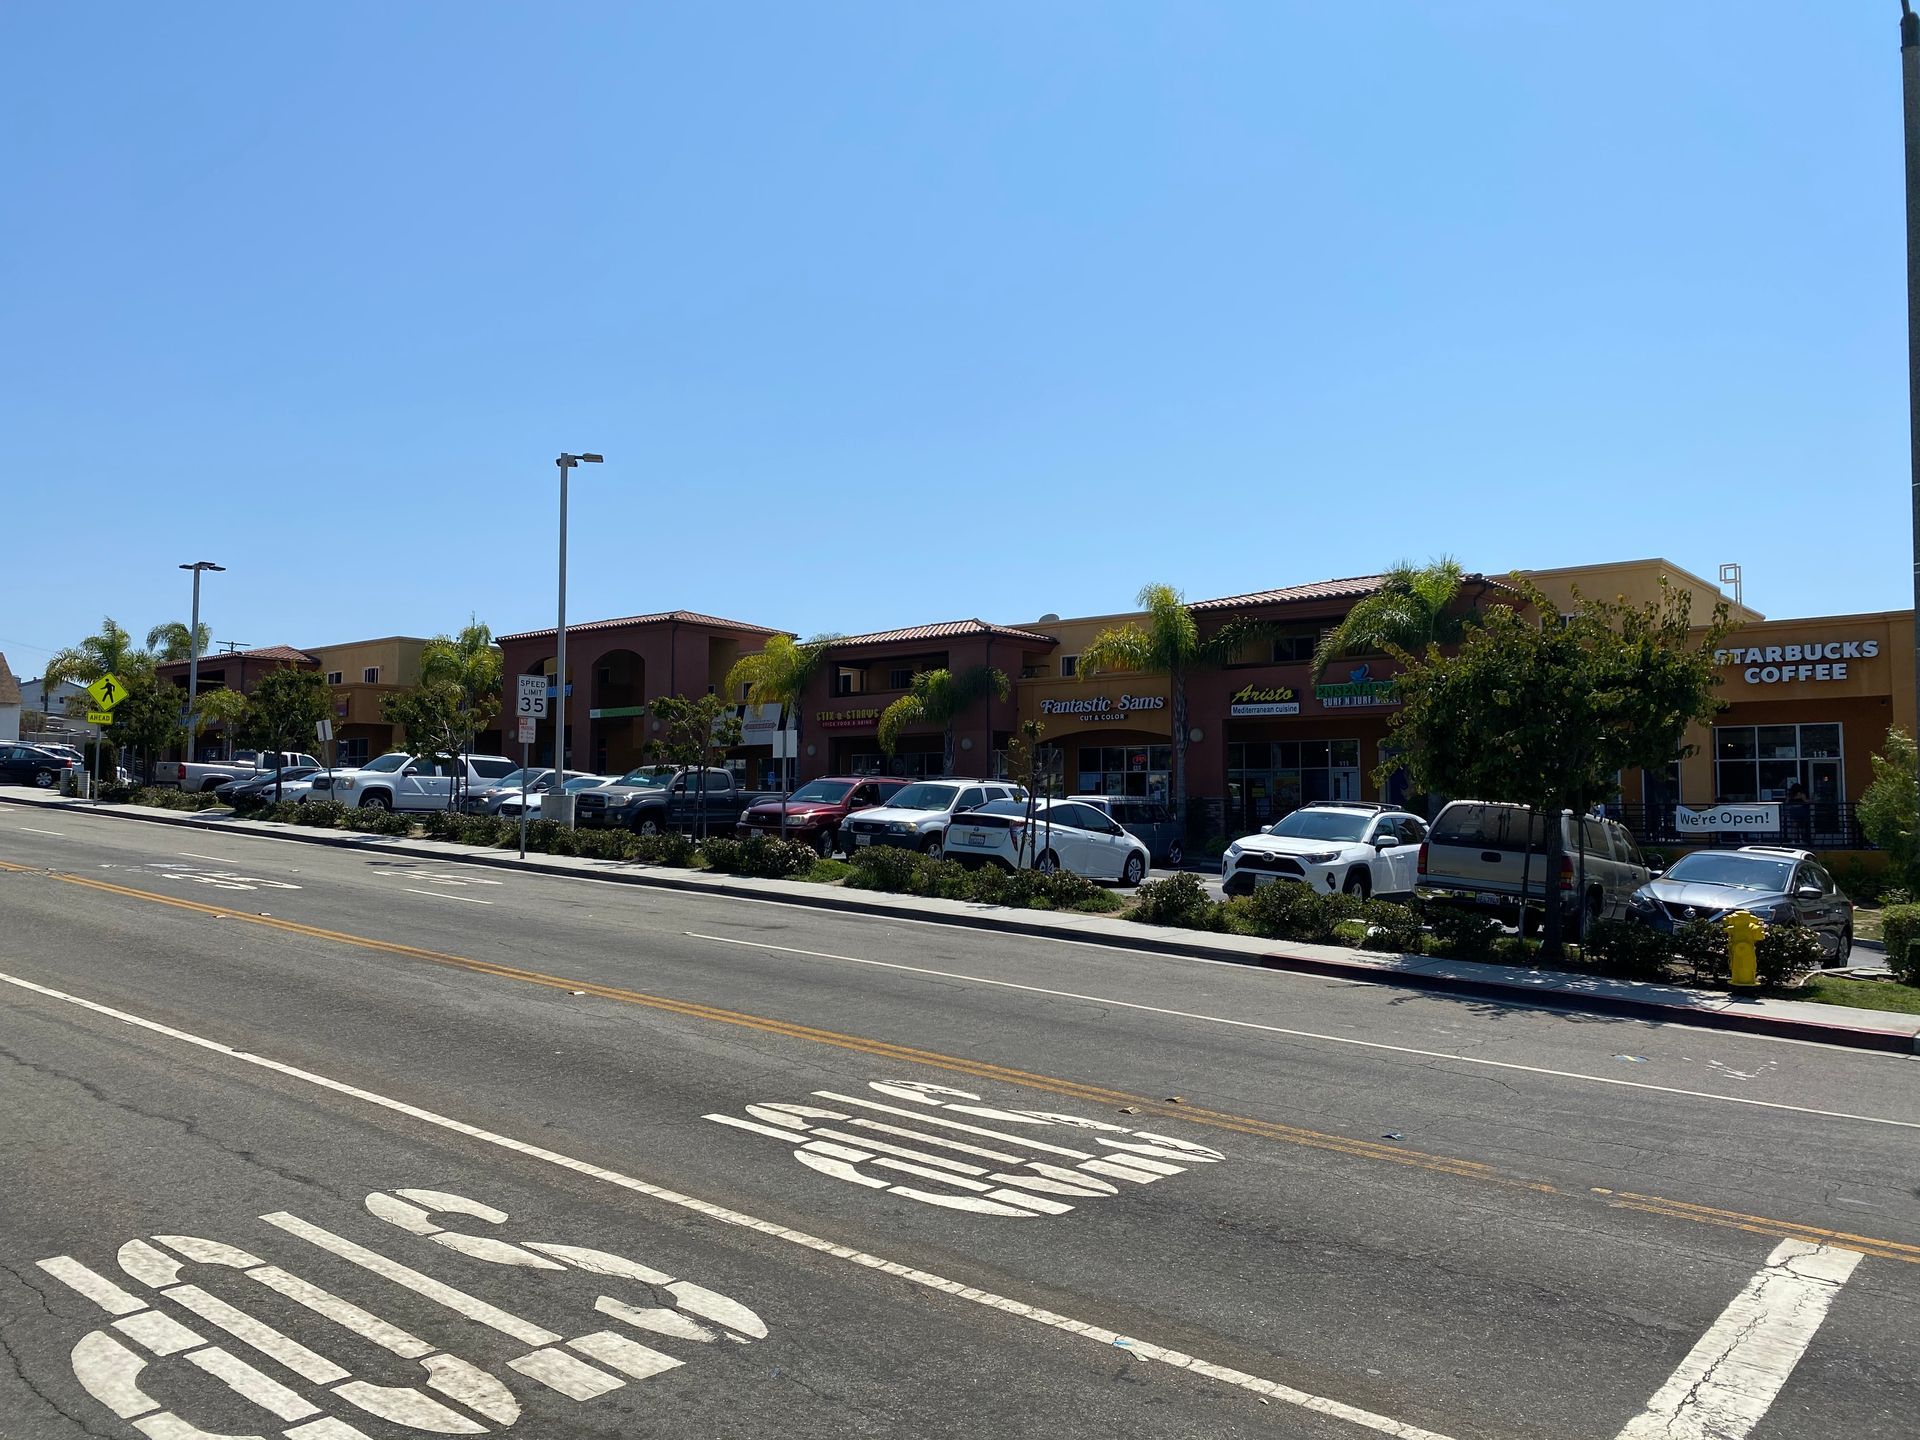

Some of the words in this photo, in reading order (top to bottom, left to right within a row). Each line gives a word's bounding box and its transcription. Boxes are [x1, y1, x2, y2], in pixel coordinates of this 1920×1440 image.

[1713, 640, 1880, 666] STARBUCKS
[1744, 663, 1848, 684] COFFEE
[520, 680, 546, 688] SPEED
[1231, 683, 1294, 703] Aristo
[520, 697, 544, 713] 35
[1040, 696, 1111, 714] Fantastic
[1118, 694, 1164, 710] Sams
[1323, 697, 1341, 706] SURF
[1353, 696, 1372, 704] TURF
[1232, 706, 1274, 714] Mediterranean
[1275, 705, 1297, 713] cuisine
[1813, 750, 1828, 758] 113
[1680, 813, 1717, 826] We're
[1720, 811, 1770, 826] Open!
